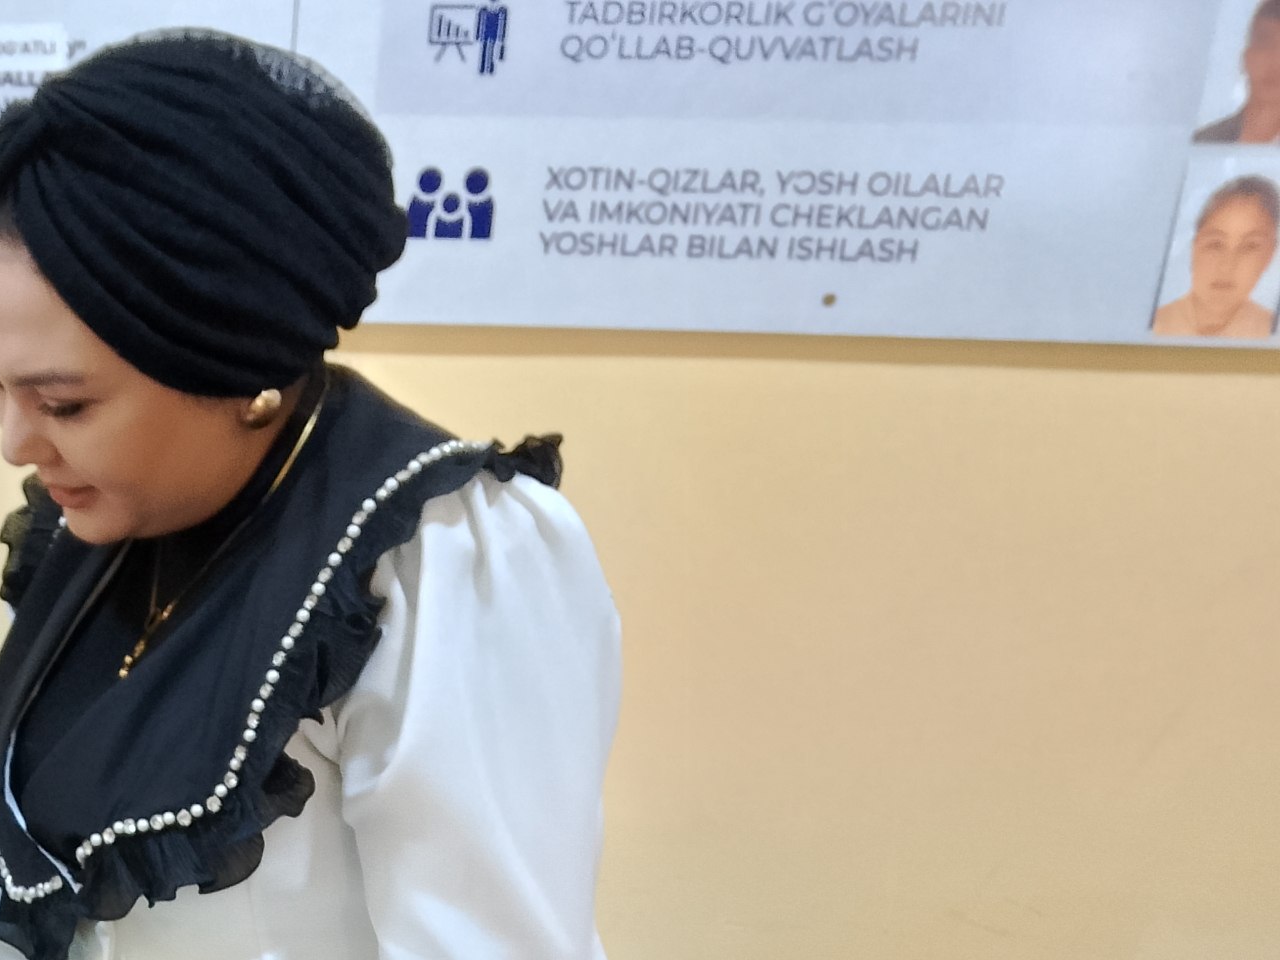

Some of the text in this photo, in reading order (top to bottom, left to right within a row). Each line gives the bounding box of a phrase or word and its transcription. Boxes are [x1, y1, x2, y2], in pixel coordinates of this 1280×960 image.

[565, 0, 794, 26] TADBIRKORLIK
[545, 166, 765, 197] XOTIN-QIZLAR,
[867, 171, 1006, 198] OILALAR
[542, 198, 991, 231] VA IMKONIYATI CHEKLANGAN
[539, 230, 920, 263] YOSHLAR BILAN ISHLASH
